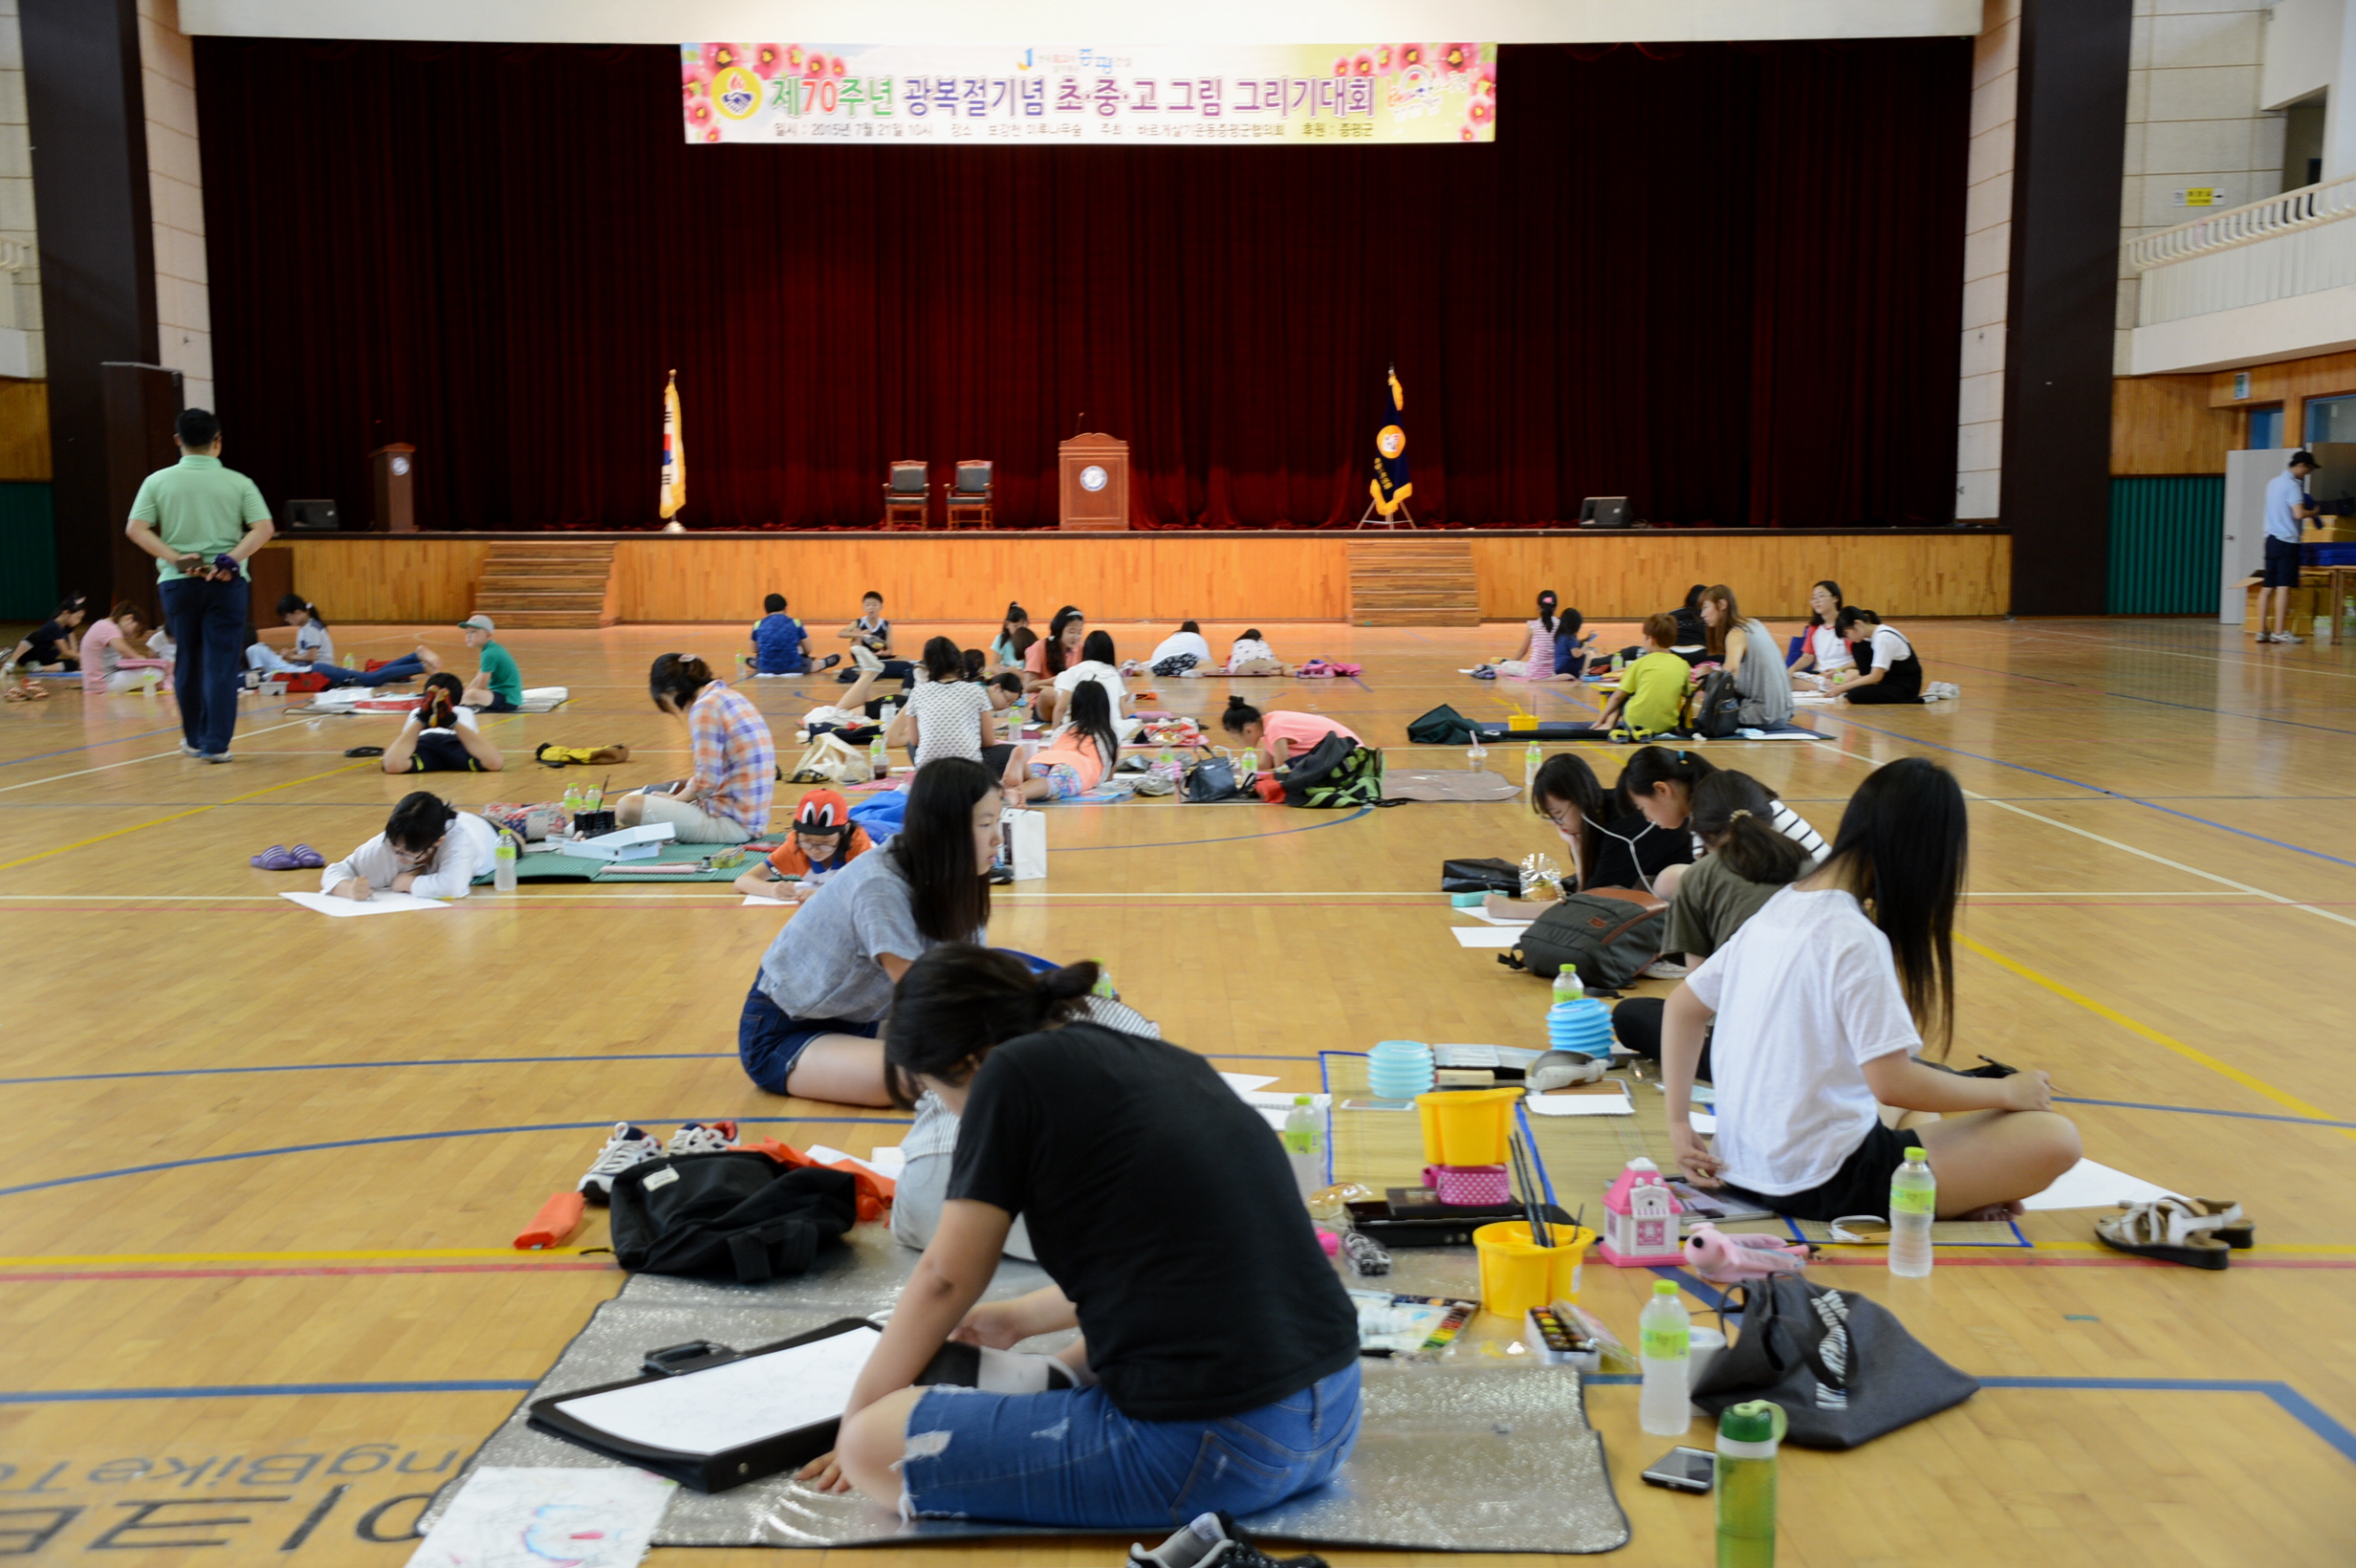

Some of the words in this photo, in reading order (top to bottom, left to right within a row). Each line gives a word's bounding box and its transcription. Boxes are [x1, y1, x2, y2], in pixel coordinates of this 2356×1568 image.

[771, 76, 894, 117] 제70주년
[904, 76, 1045, 118] 광복절기념
[1167, 77, 1223, 118] 그림
[1233, 76, 1377, 118] 그리기대회
[855, 122, 874, 137] 7월
[878, 122, 903, 137] 21일
